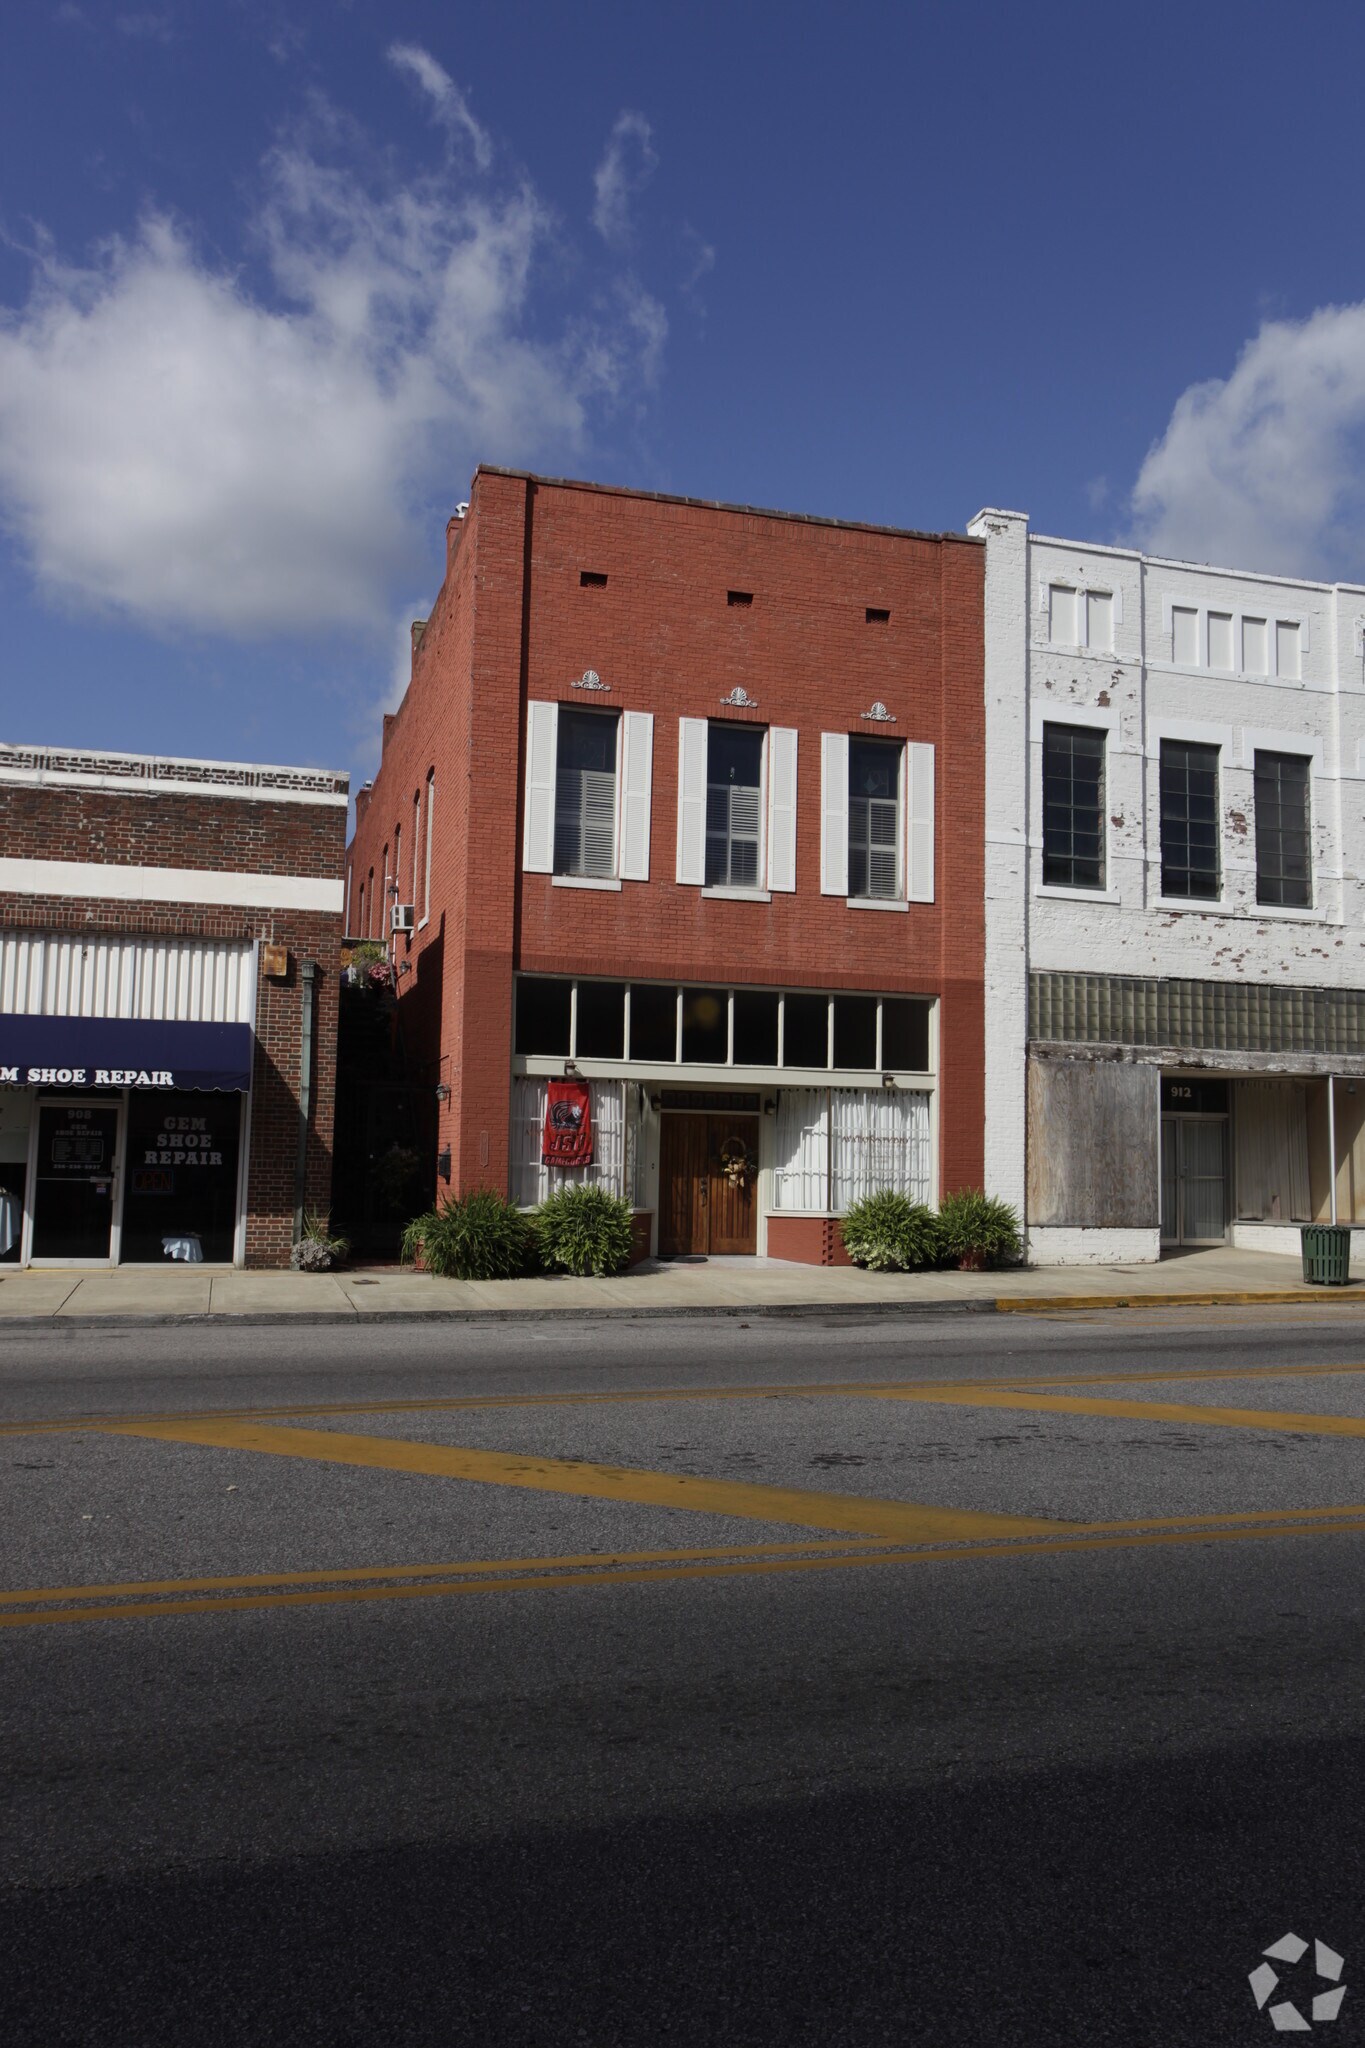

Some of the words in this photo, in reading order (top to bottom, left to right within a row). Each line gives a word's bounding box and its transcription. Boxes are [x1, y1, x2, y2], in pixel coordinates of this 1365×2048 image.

[27, 1068, 86, 1083] SHOE
[95, 1069, 174, 1086] REPAIR
[1170, 1086, 1192, 1098] 912
[67, 1110, 92, 1119] 908
[164, 1116, 207, 1131] GEM
[157, 1133, 212, 1148] SHOE
[144, 1150, 223, 1165] REPAIR
[134, 1171, 172, 1190] OPEN
